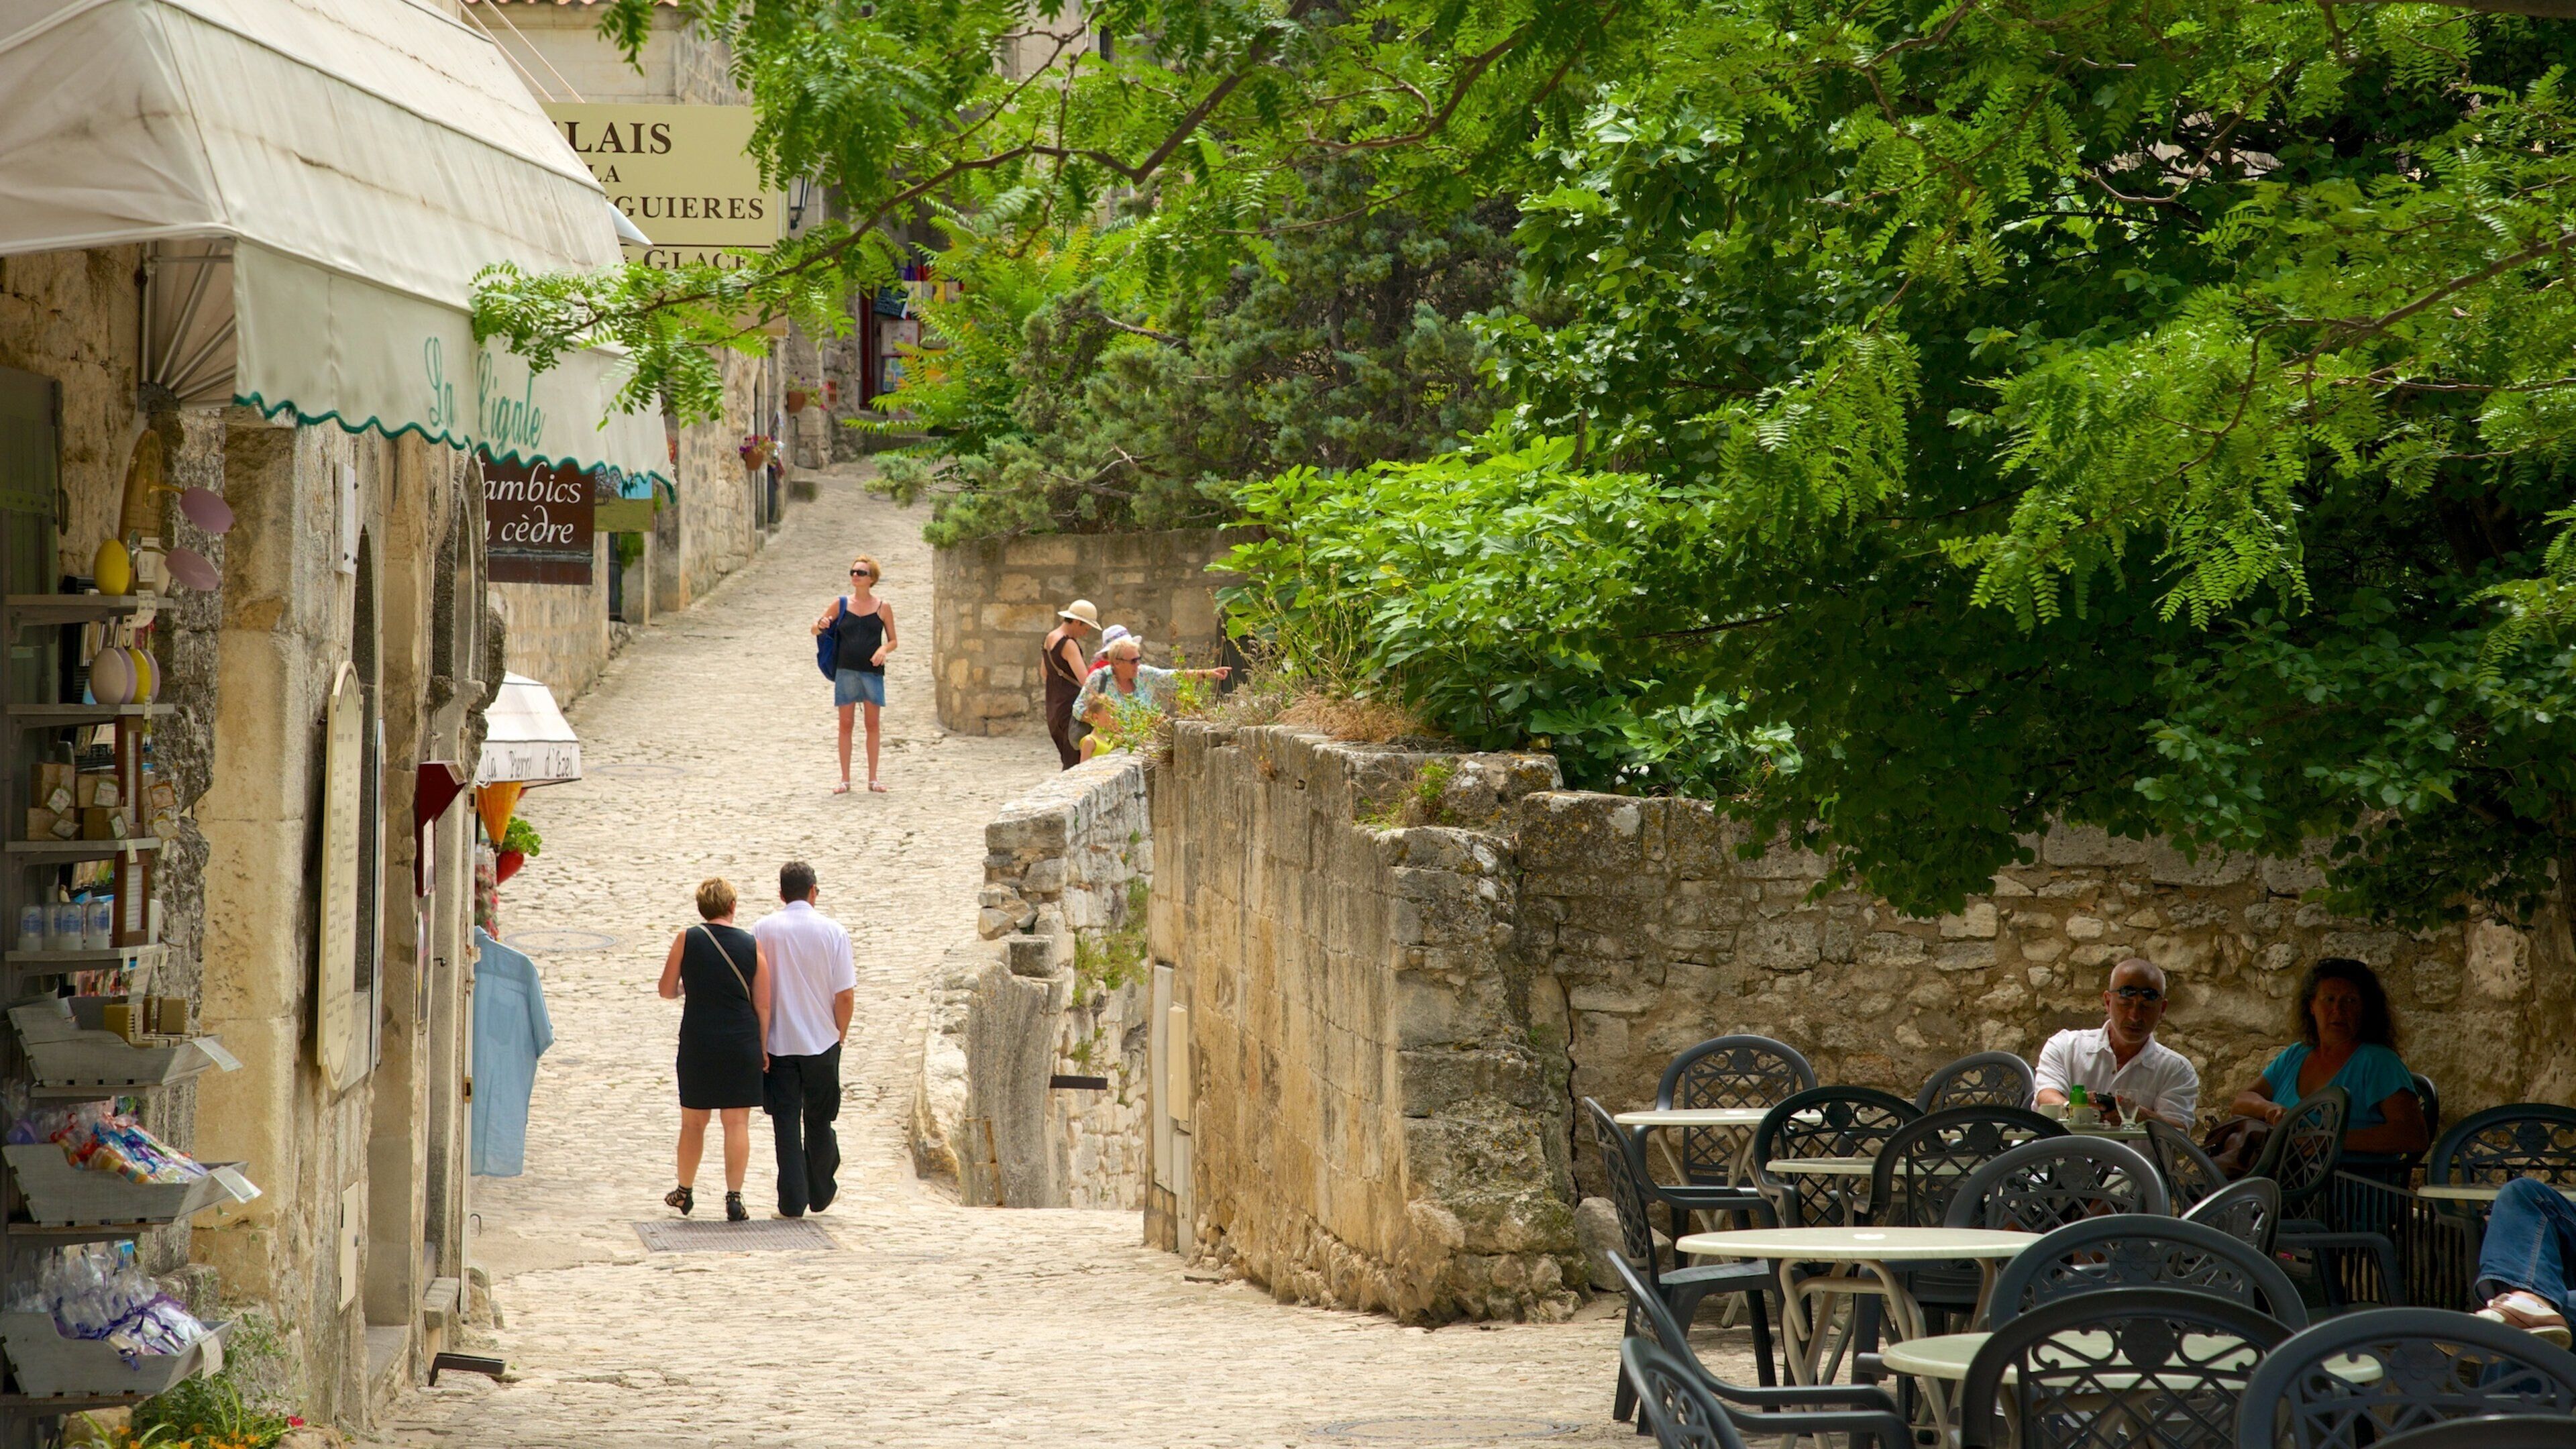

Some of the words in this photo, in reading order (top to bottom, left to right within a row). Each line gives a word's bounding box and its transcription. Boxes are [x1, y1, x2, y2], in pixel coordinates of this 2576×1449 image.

[553, 121, 672, 154] LAIS
[605, 195, 764, 220] GUIERES
[643, 249, 765, 271] GLACE
[425, 336, 455, 428] La
[476, 351, 547, 460] Cigale
[482, 461, 582, 503] ambics
[501, 504, 574, 543] cèdre
